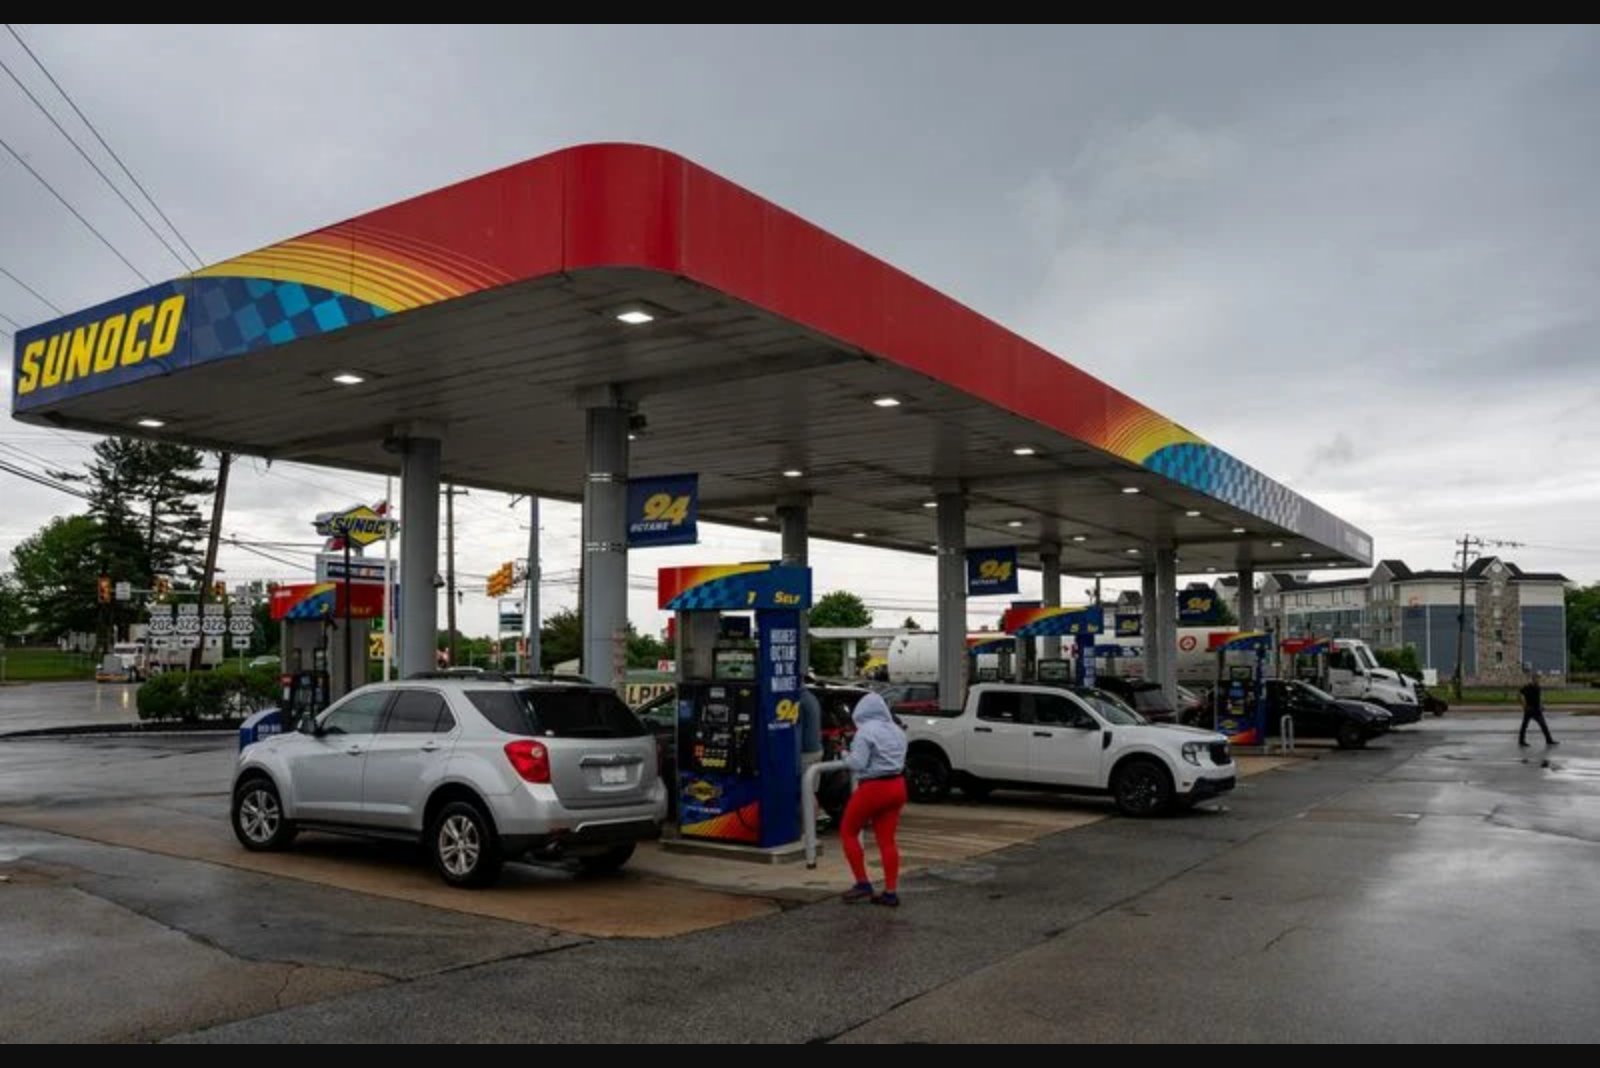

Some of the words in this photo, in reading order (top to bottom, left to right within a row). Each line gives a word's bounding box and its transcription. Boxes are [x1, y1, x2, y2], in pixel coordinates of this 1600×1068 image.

[17, 294, 185, 395] SUNOCO
[643, 493, 691, 525] 94
[630, 521, 669, 533] OCTANE
[980, 560, 1013, 582] 94
[150, 620, 173, 632] 202
[203, 620, 226, 632] 322
[230, 620, 254, 632] 202
[776, 699, 799, 725] 94
